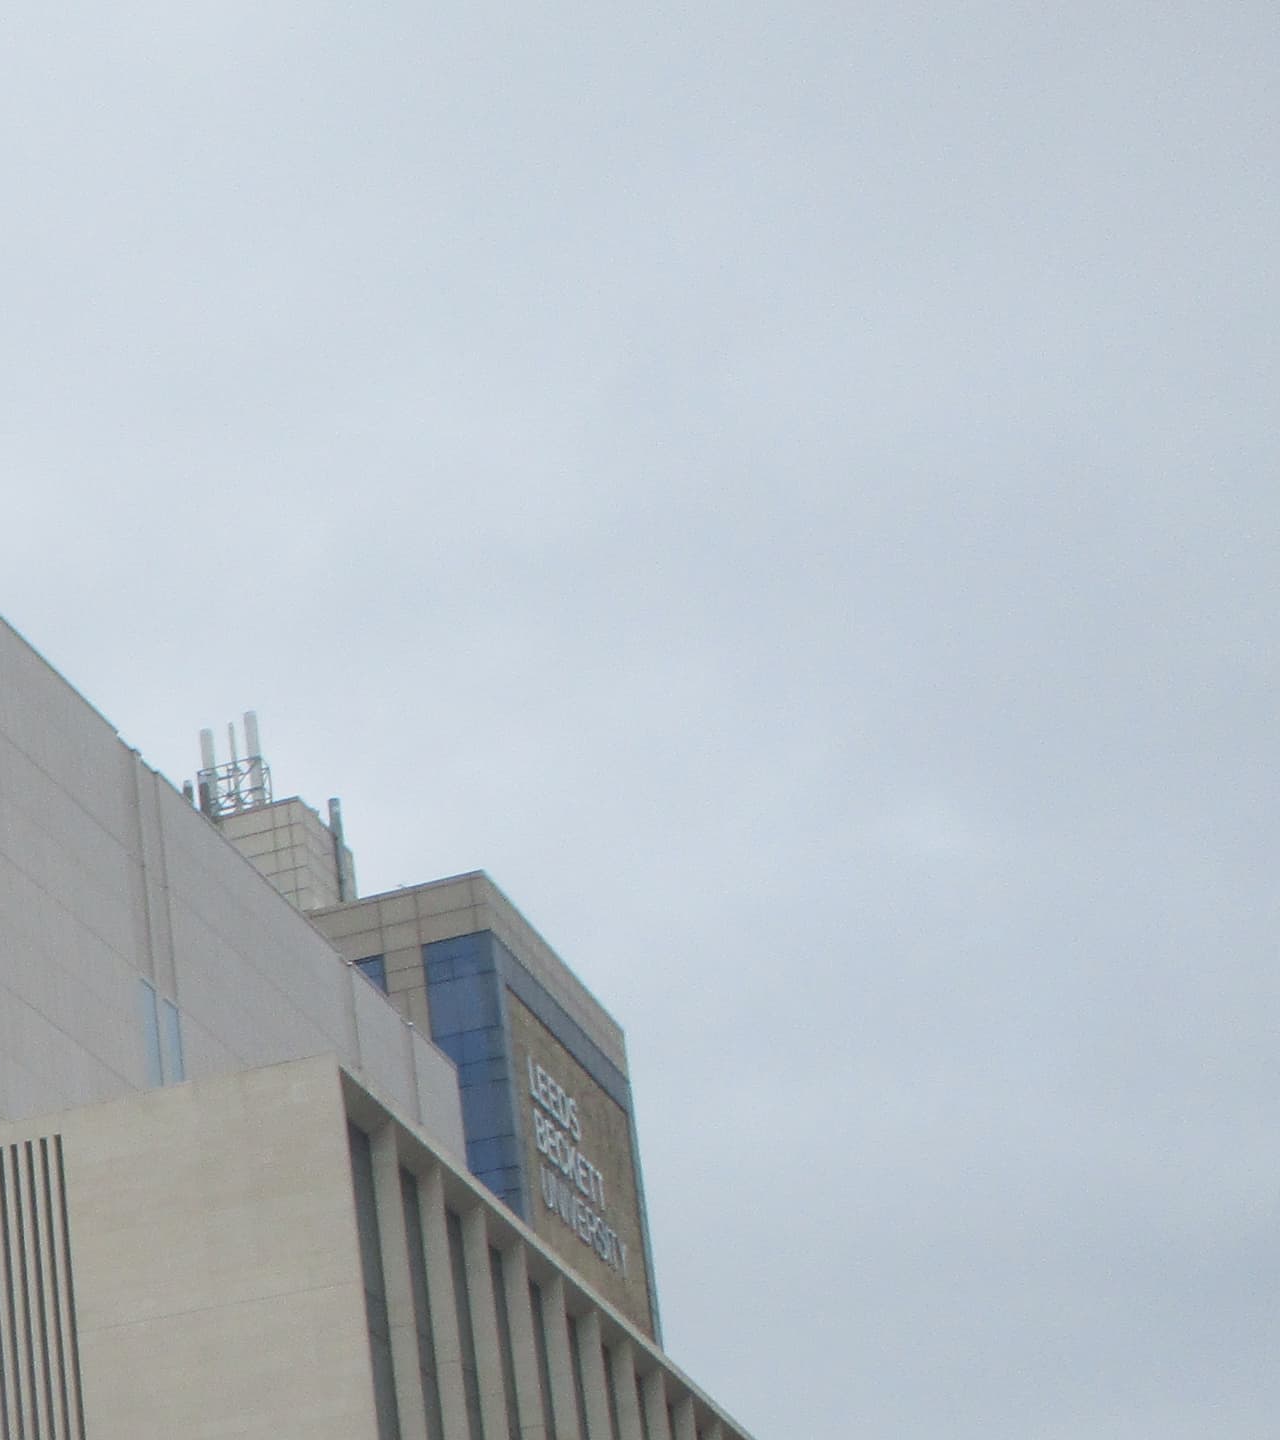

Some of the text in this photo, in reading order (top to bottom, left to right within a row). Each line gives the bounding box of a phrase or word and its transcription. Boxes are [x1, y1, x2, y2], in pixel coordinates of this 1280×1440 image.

[527, 1056, 582, 1143] LEEDS
[533, 1107, 606, 1211] BECKETT
[540, 1163, 628, 1280] UNIVERSITY
